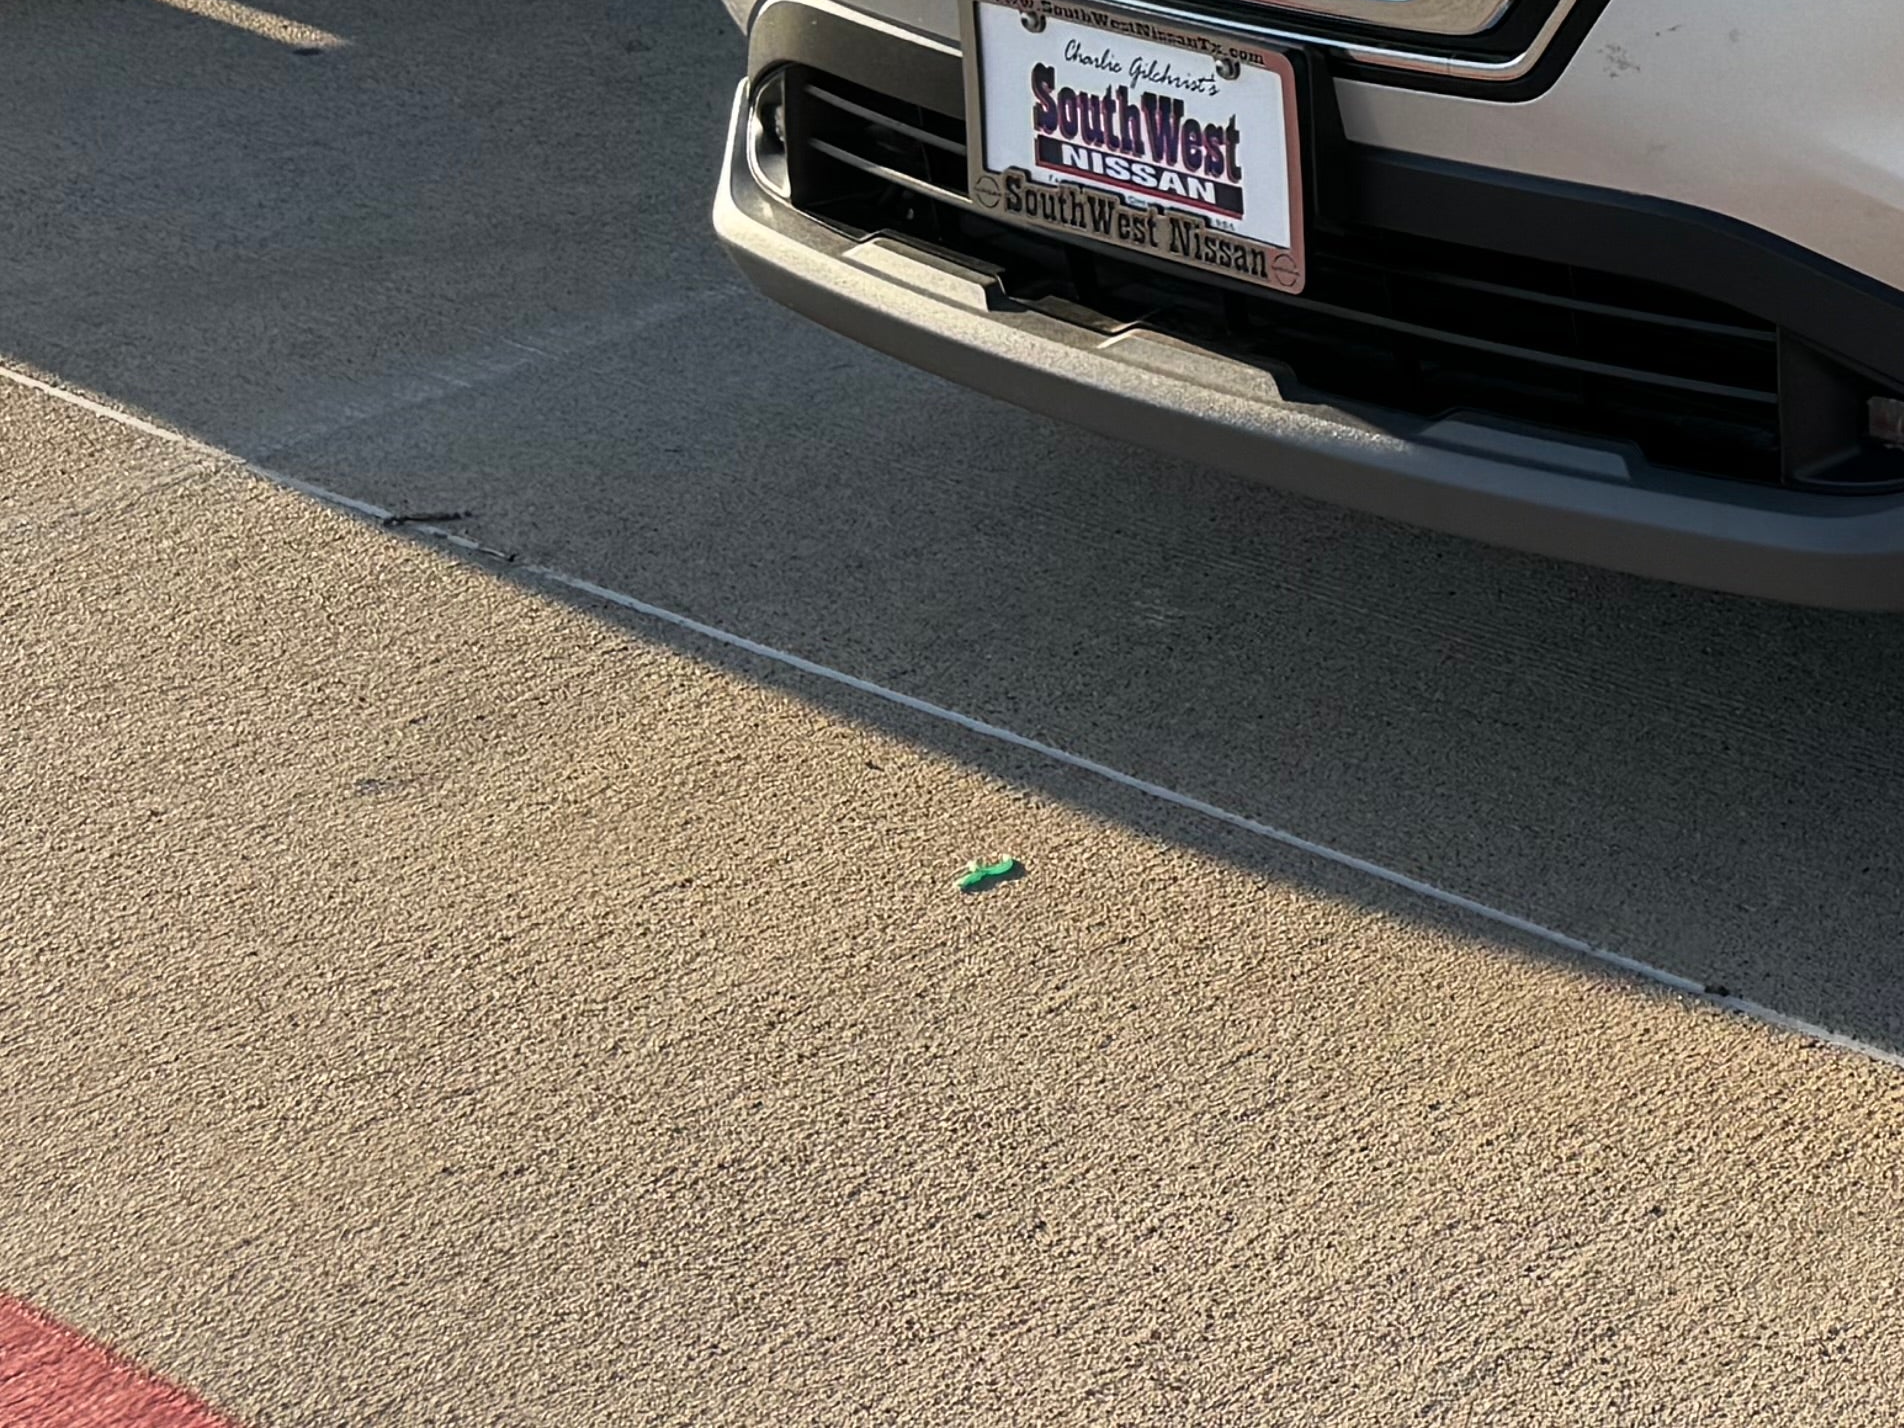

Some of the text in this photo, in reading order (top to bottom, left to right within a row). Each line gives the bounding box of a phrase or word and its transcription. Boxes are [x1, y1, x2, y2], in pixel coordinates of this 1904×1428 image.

[1064, 39, 1220, 96] Charlie Gilchrist's
[1031, 62, 1242, 183] SouthWest
[1062, 147, 1215, 204] NISSAN
[1005, 176, 1268, 278] SouthWest Nissan
